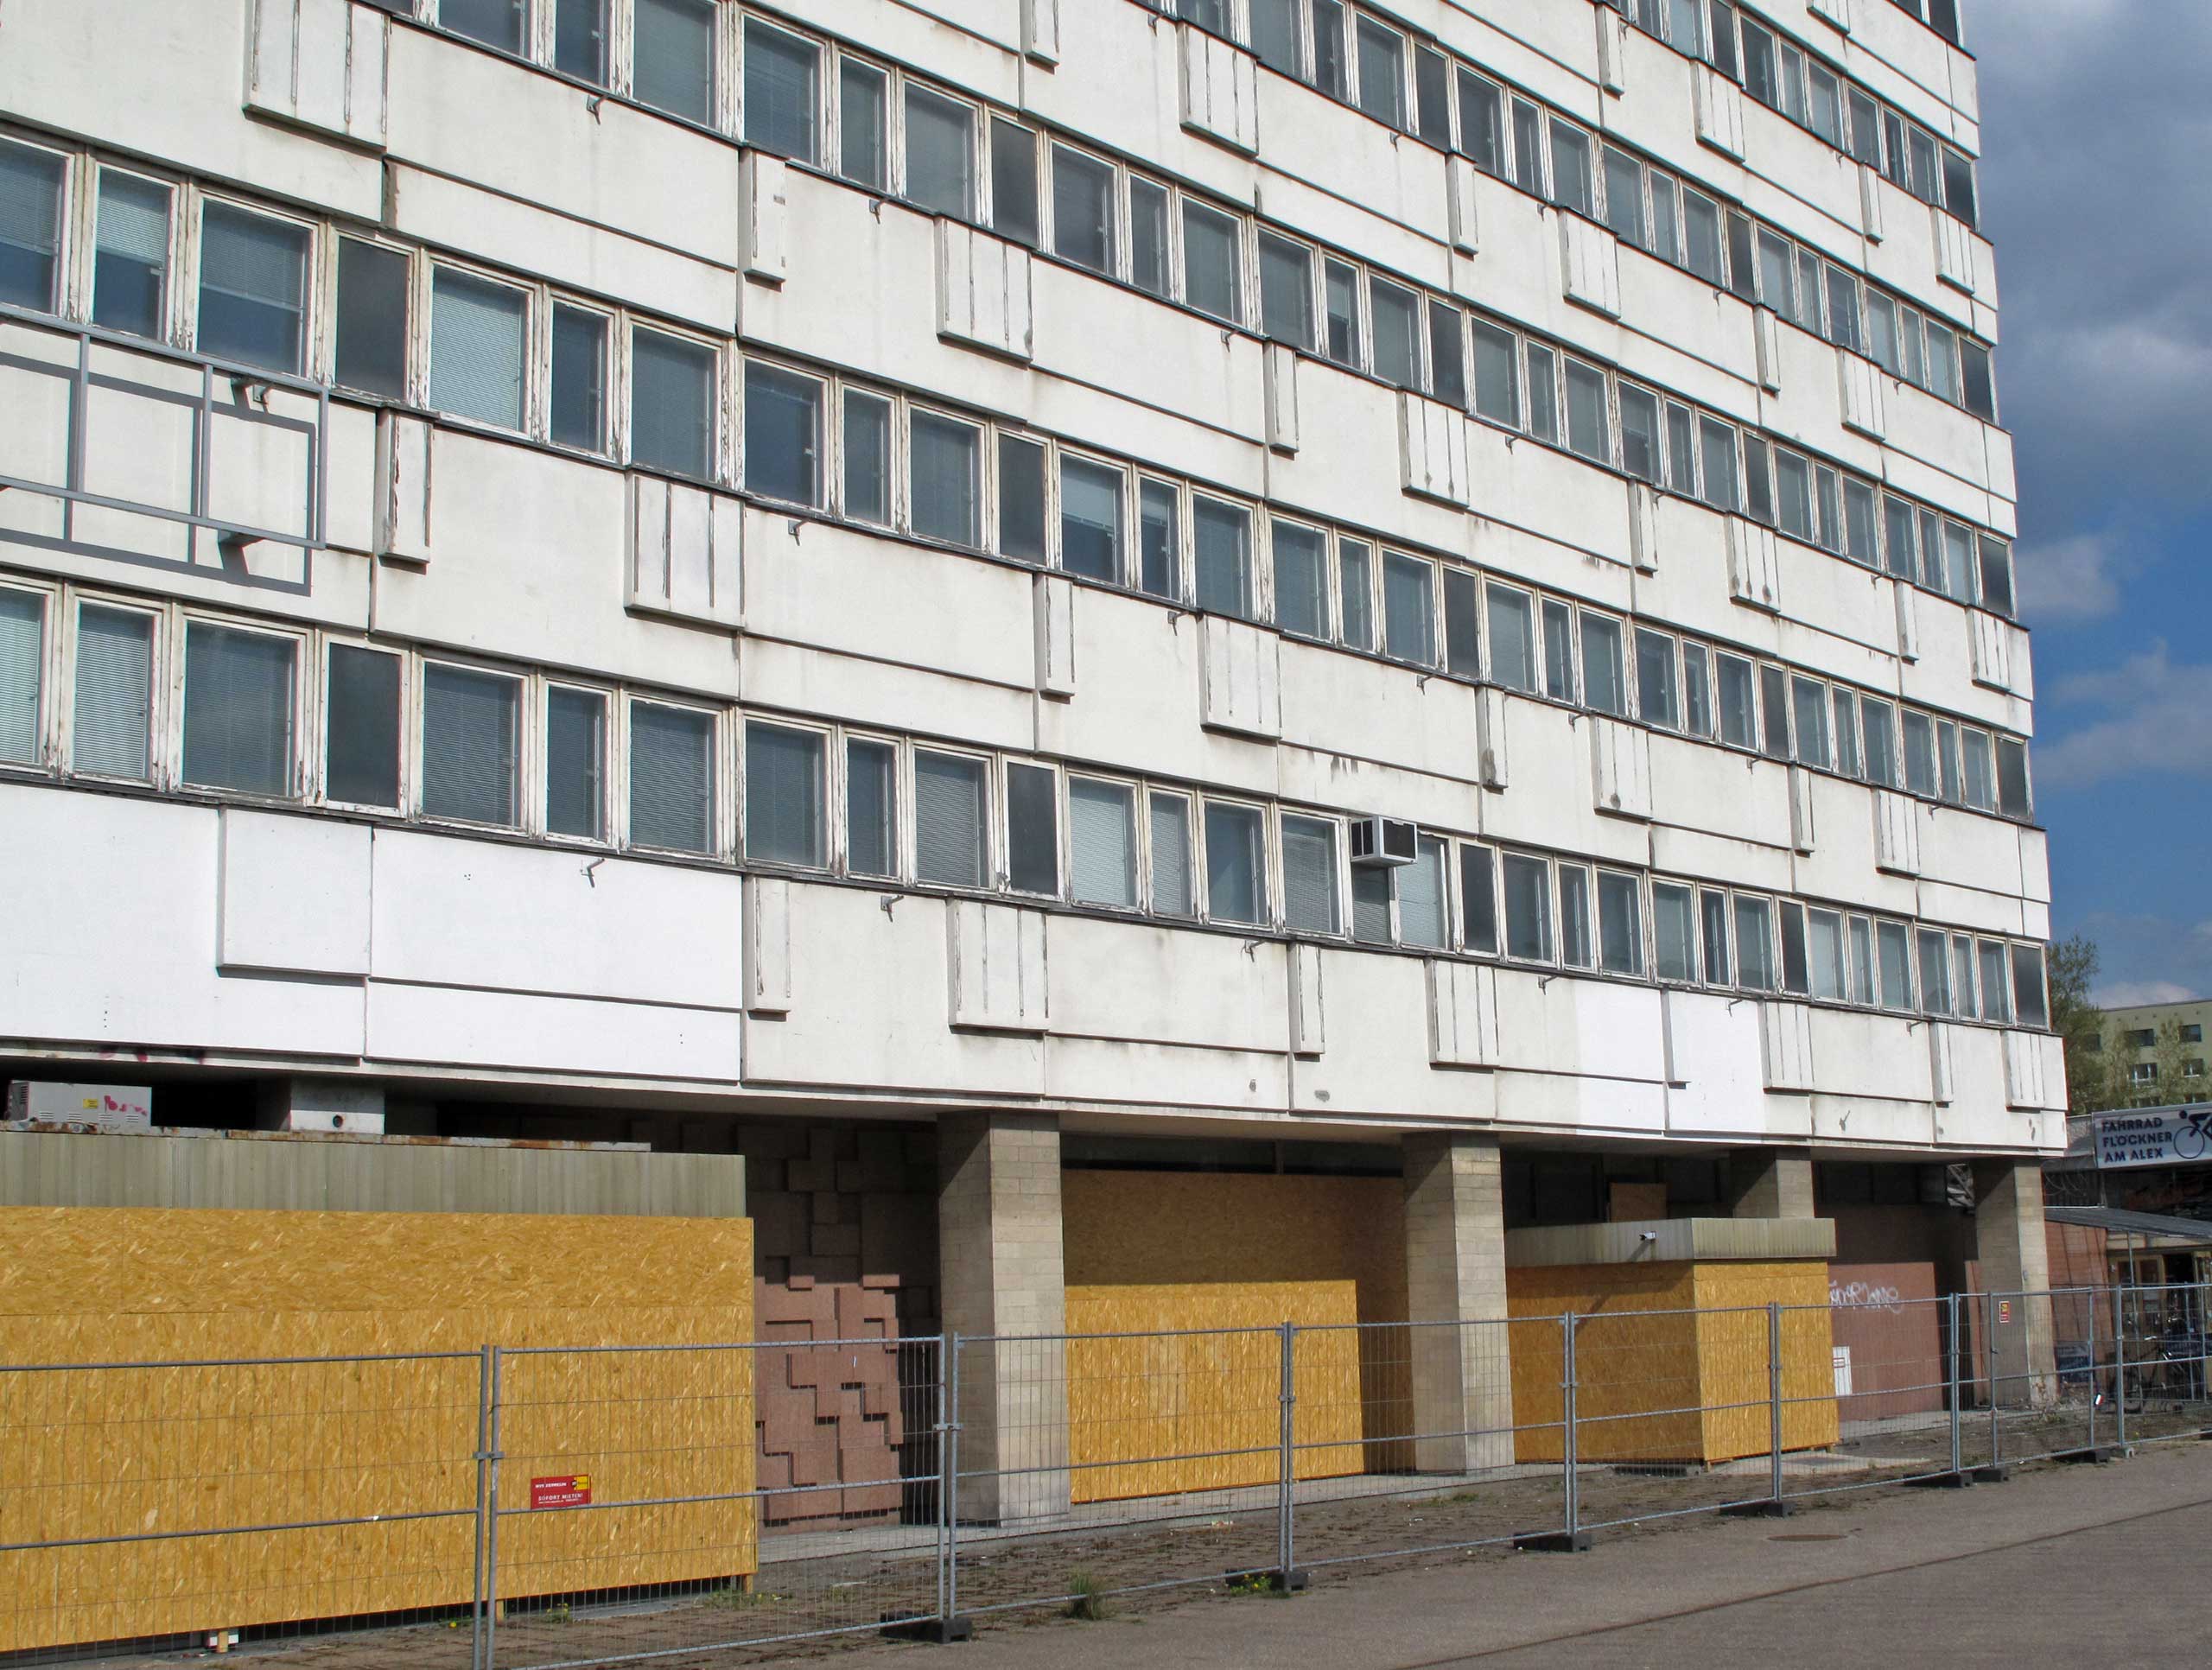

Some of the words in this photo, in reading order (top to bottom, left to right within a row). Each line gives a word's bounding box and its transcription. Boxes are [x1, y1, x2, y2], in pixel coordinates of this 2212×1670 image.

[2101, 1117, 2163, 1133] FAHRRAD
[2104, 1151, 2126, 1163] AM
[2130, 1147, 2164, 1160] ALEX
